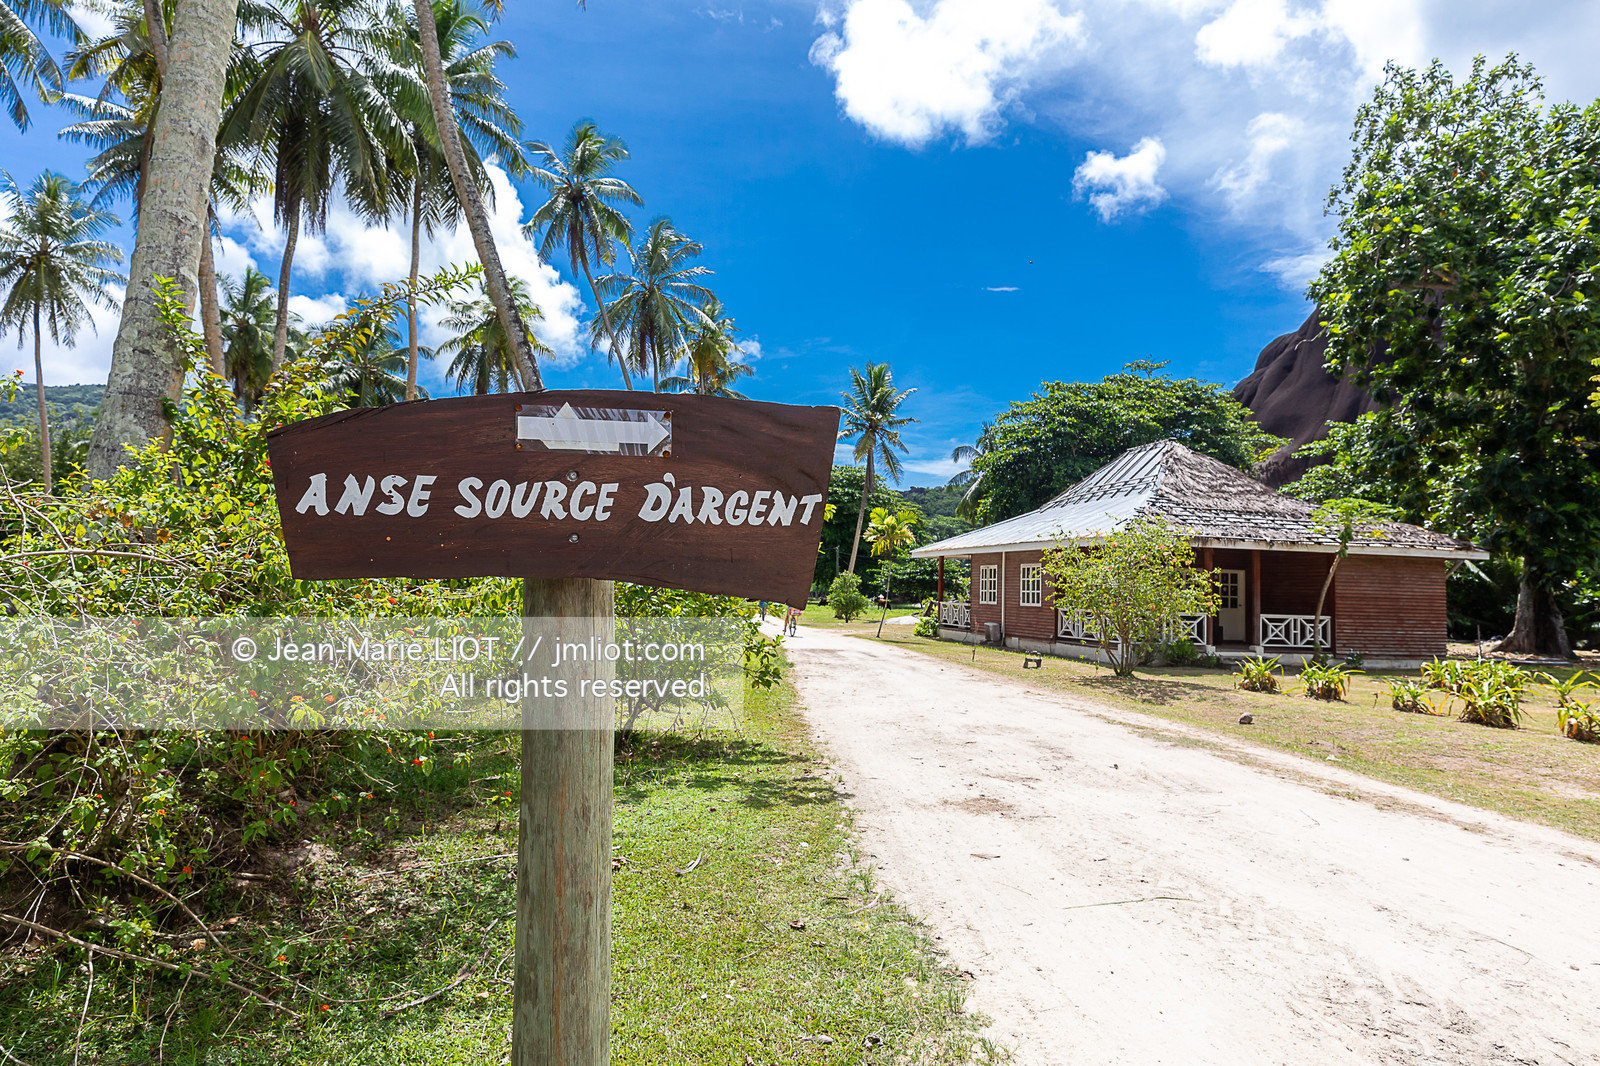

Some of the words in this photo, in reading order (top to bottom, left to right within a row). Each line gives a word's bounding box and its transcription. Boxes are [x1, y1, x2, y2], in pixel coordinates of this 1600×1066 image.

[295, 472, 437, 518] ANSE
[453, 476, 619, 522] SOURCE
[637, 472, 823, 527] D'ARGENT
